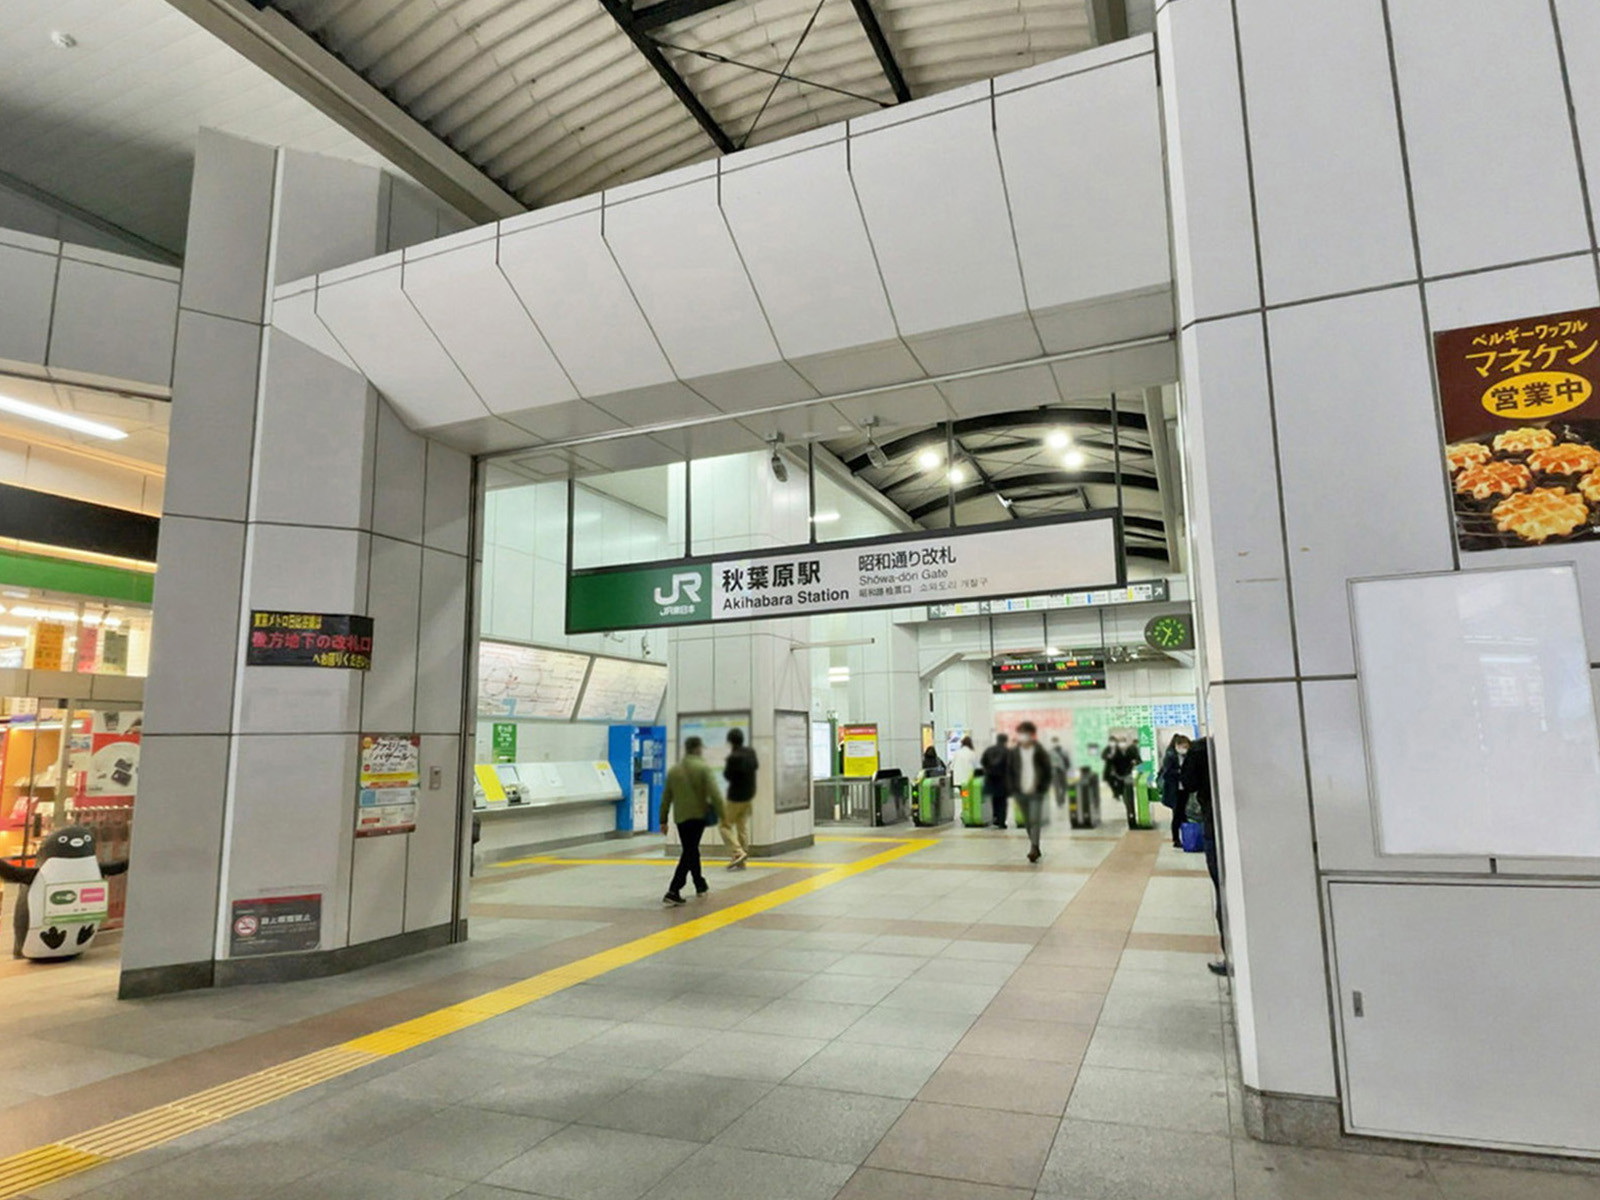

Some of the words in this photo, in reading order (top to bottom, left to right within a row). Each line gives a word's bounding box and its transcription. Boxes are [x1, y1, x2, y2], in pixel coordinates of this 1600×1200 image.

[1471, 320, 1588, 346] ベルギーワッフル
[1464, 339, 1599, 378] マネケン
[1490, 377, 1584, 412] 営業中
[858, 545, 957, 572] 昭和通り改札
[654, 572, 702, 605] JR
[722, 560, 821, 593] 秋葉原駅
[921, 568, 949, 580] Gate
[722, 594, 793, 611] Akihabara
[797, 588, 850, 604] Station
